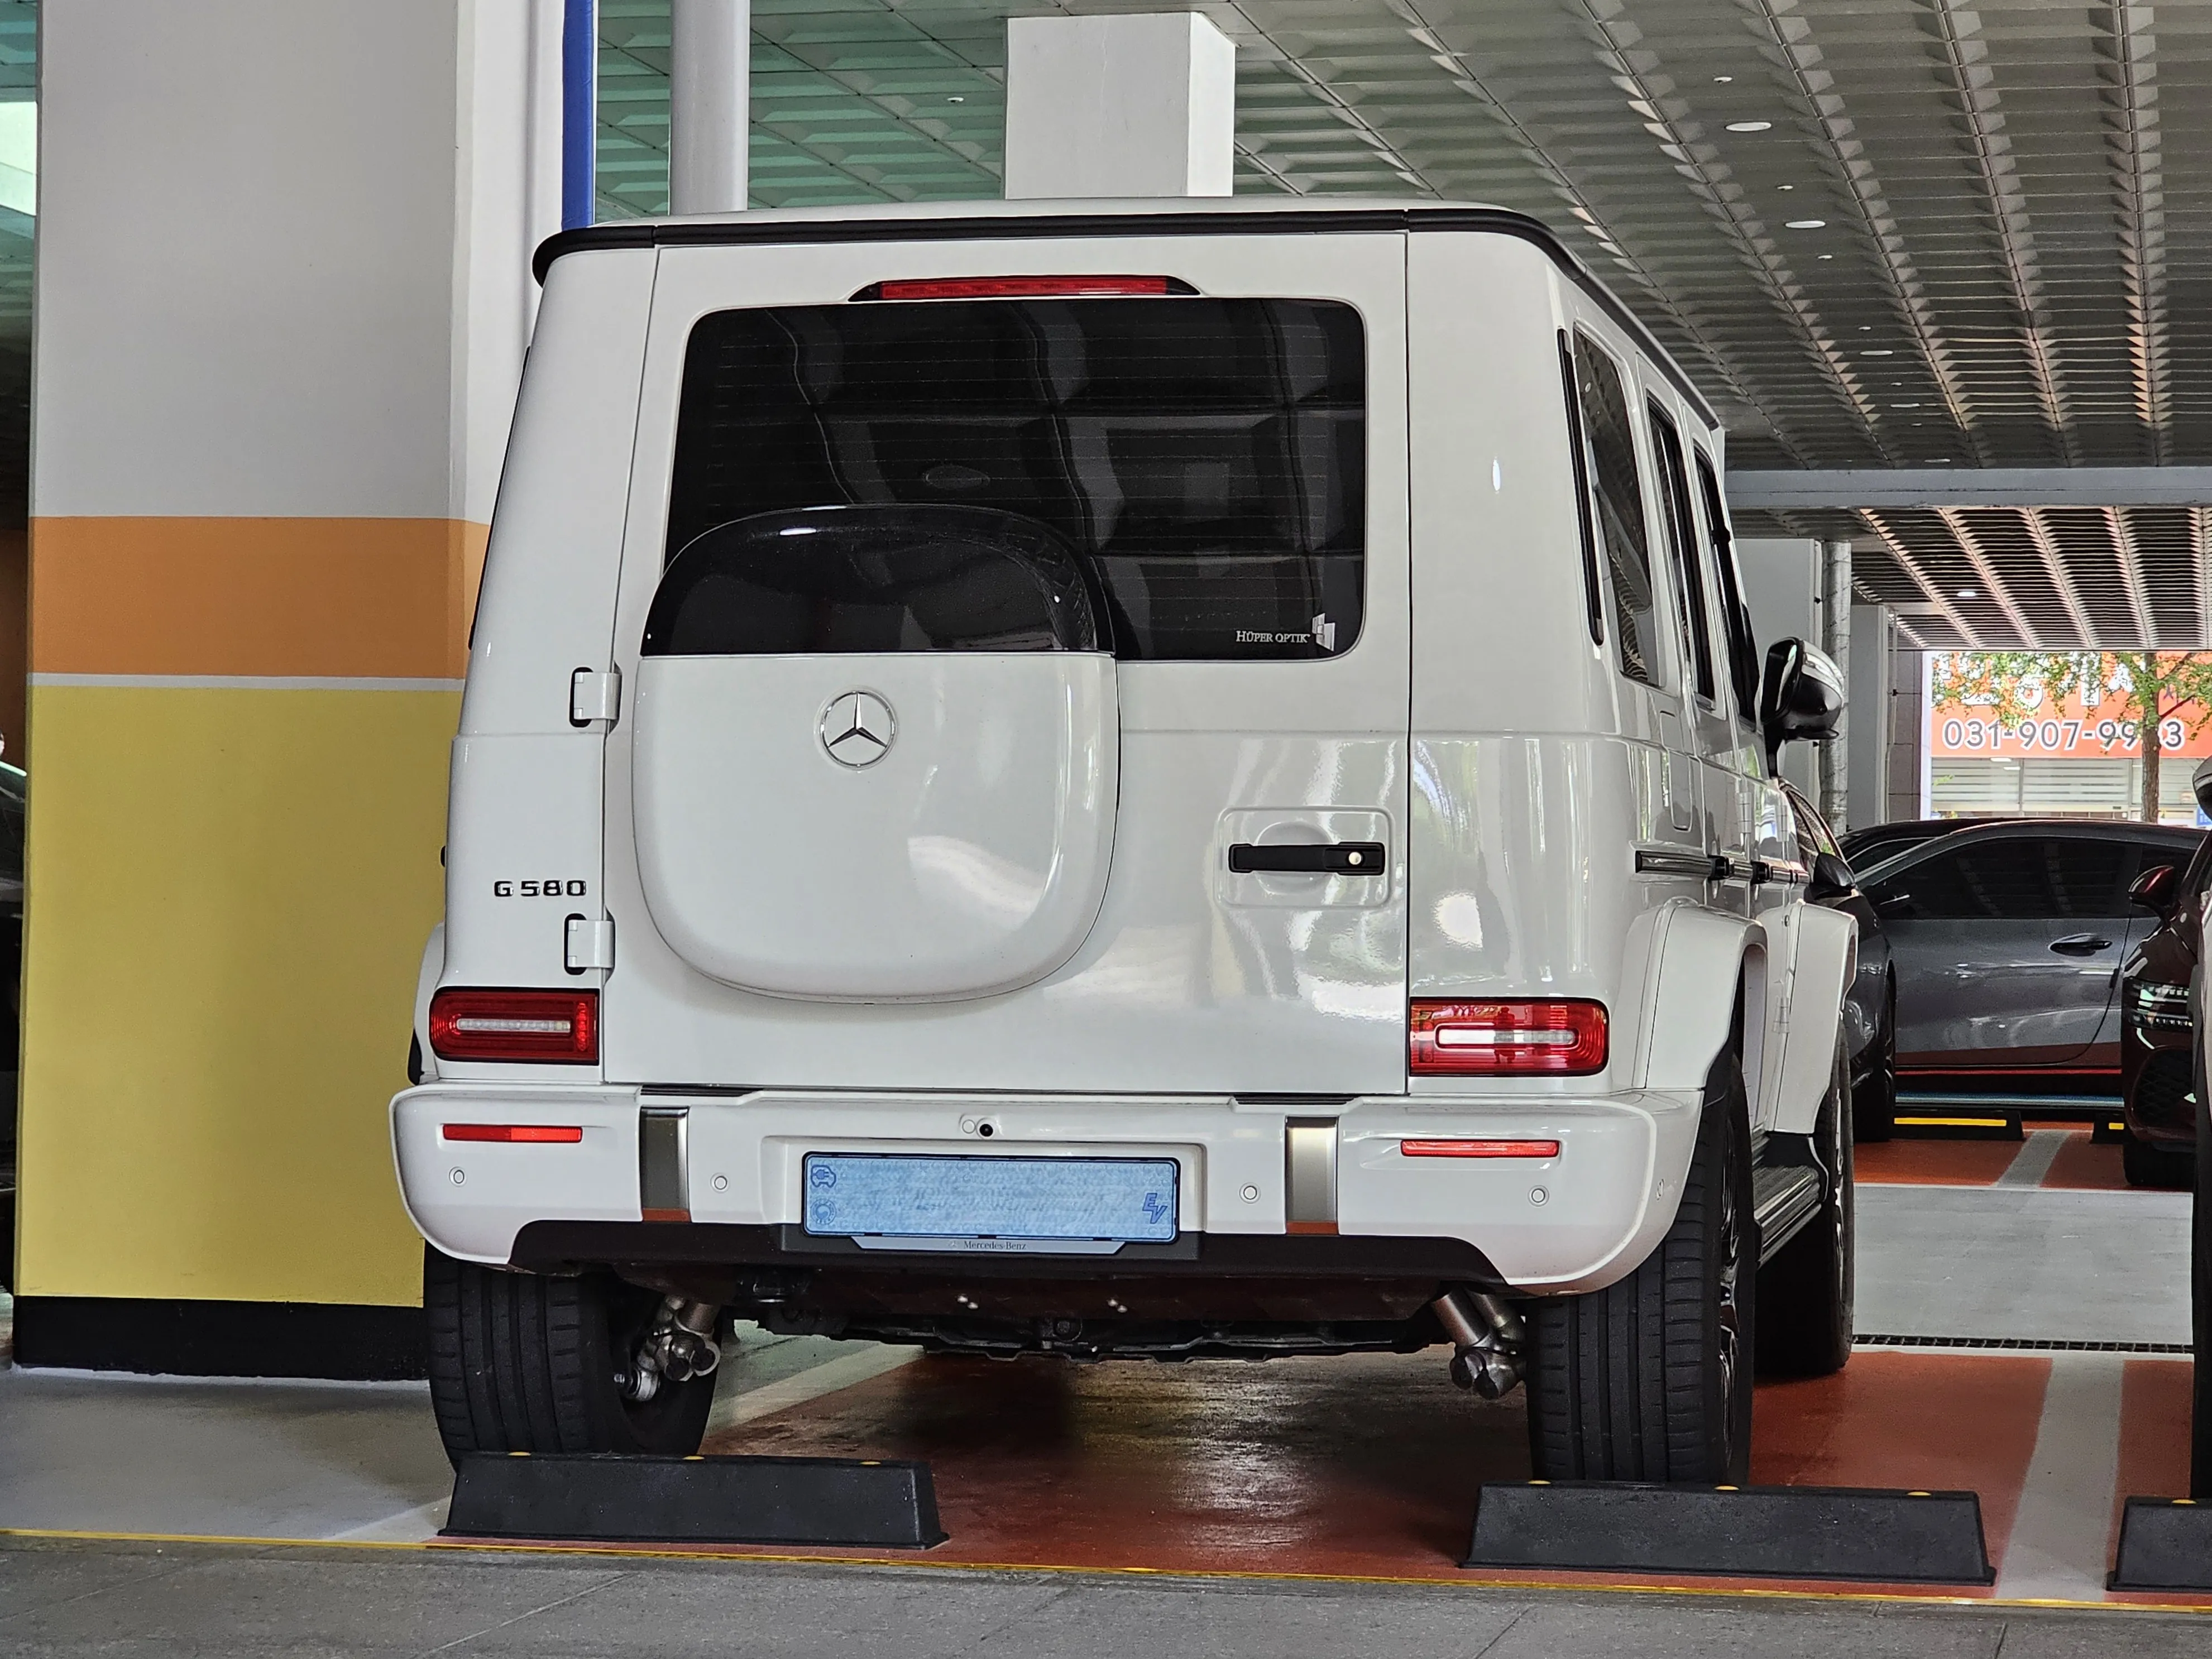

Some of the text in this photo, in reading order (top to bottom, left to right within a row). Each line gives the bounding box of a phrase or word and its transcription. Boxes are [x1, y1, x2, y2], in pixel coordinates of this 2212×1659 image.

[1236, 630, 1310, 643] HÜPER OPTIK
[1942, 718, 2185, 751] 031-907-993
[494, 880, 587, 897] G 580
[1142, 1192, 1168, 1224] EV
